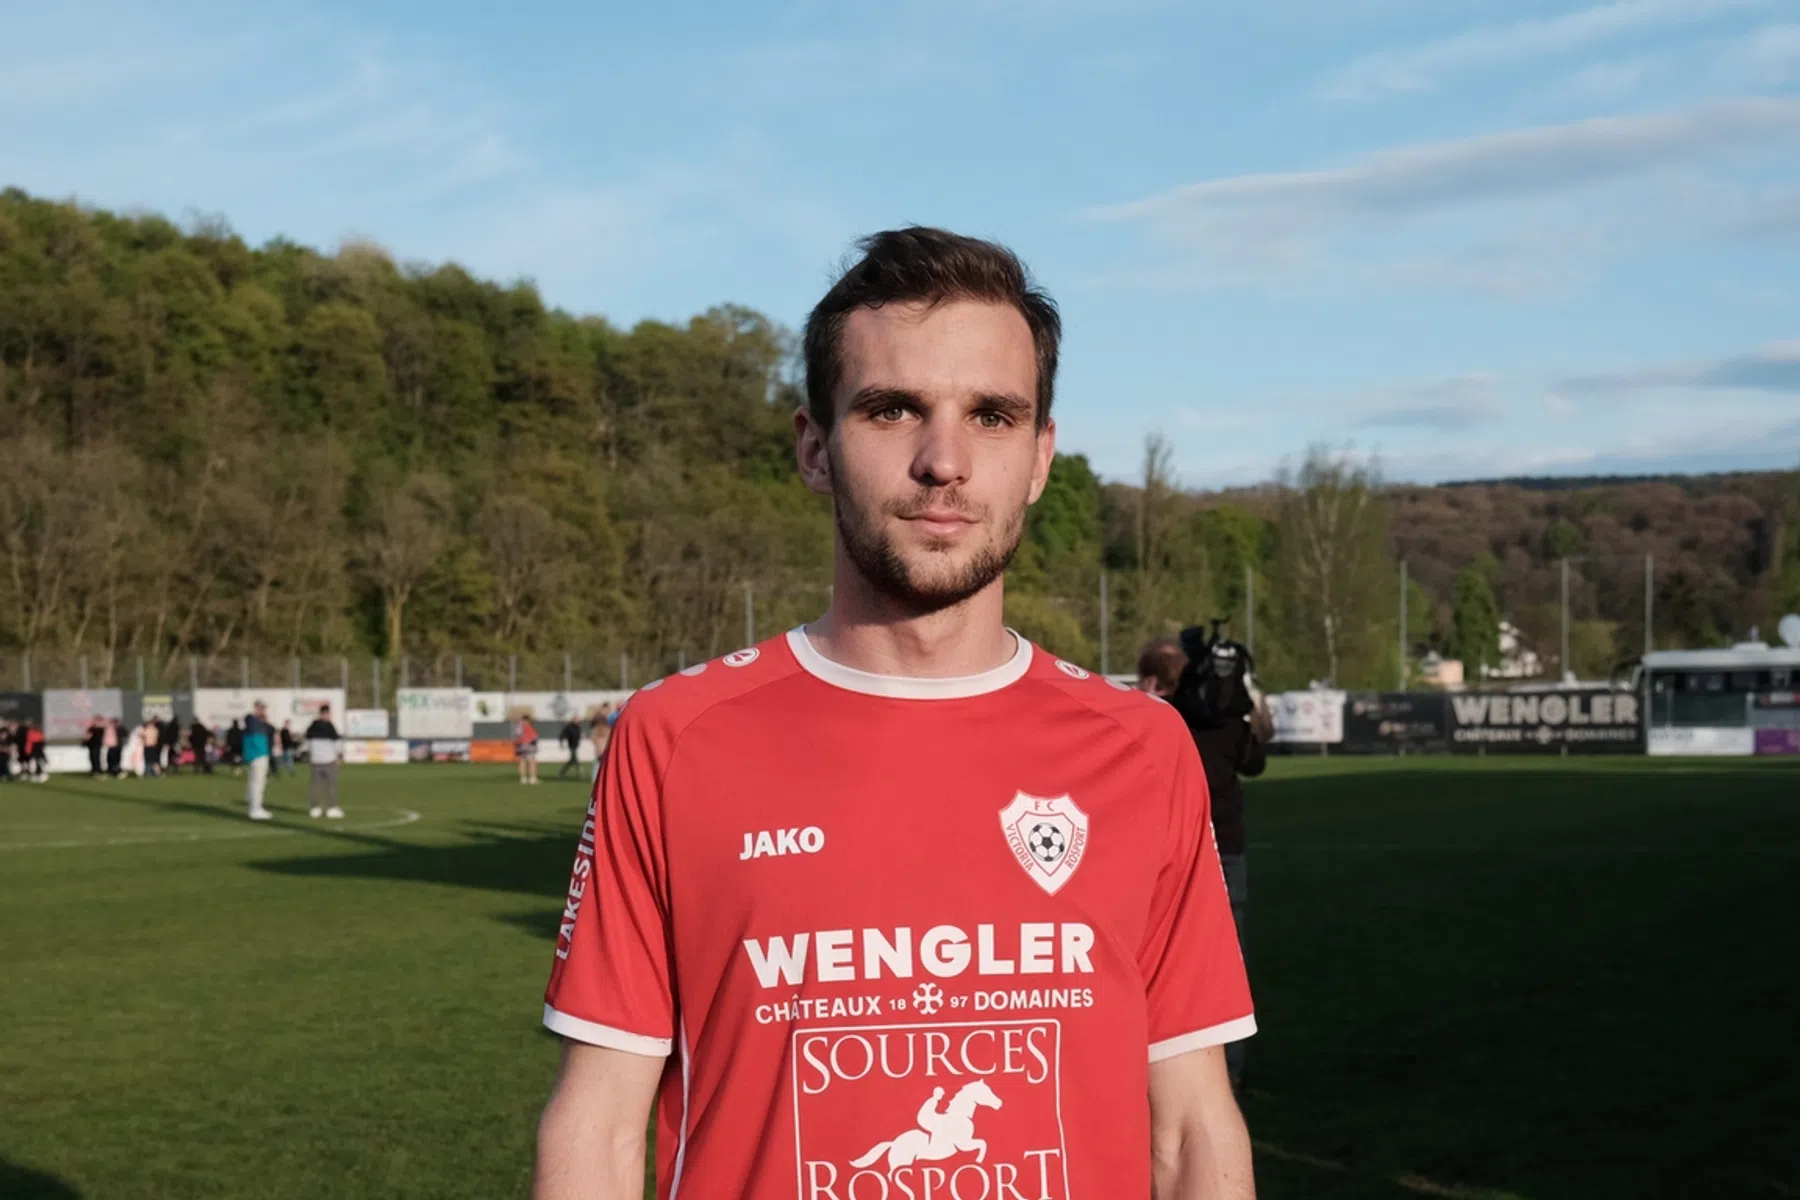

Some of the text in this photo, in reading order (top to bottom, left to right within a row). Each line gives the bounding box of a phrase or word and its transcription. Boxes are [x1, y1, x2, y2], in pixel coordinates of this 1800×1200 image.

[1452, 695, 1639, 725] WENGLER
[739, 826, 825, 860] JAKO
[1006, 823, 1035, 871] VICTORIA
[1064, 826, 1086, 870] ROSPORT
[743, 922, 1096, 989] WENGLER
[755, 988, 1094, 1025] CHÂTEAUX 18 97 DOMAINES
[802, 1026, 1049, 1094] SOURCES
[804, 1149, 1061, 1200] ROSPORT
